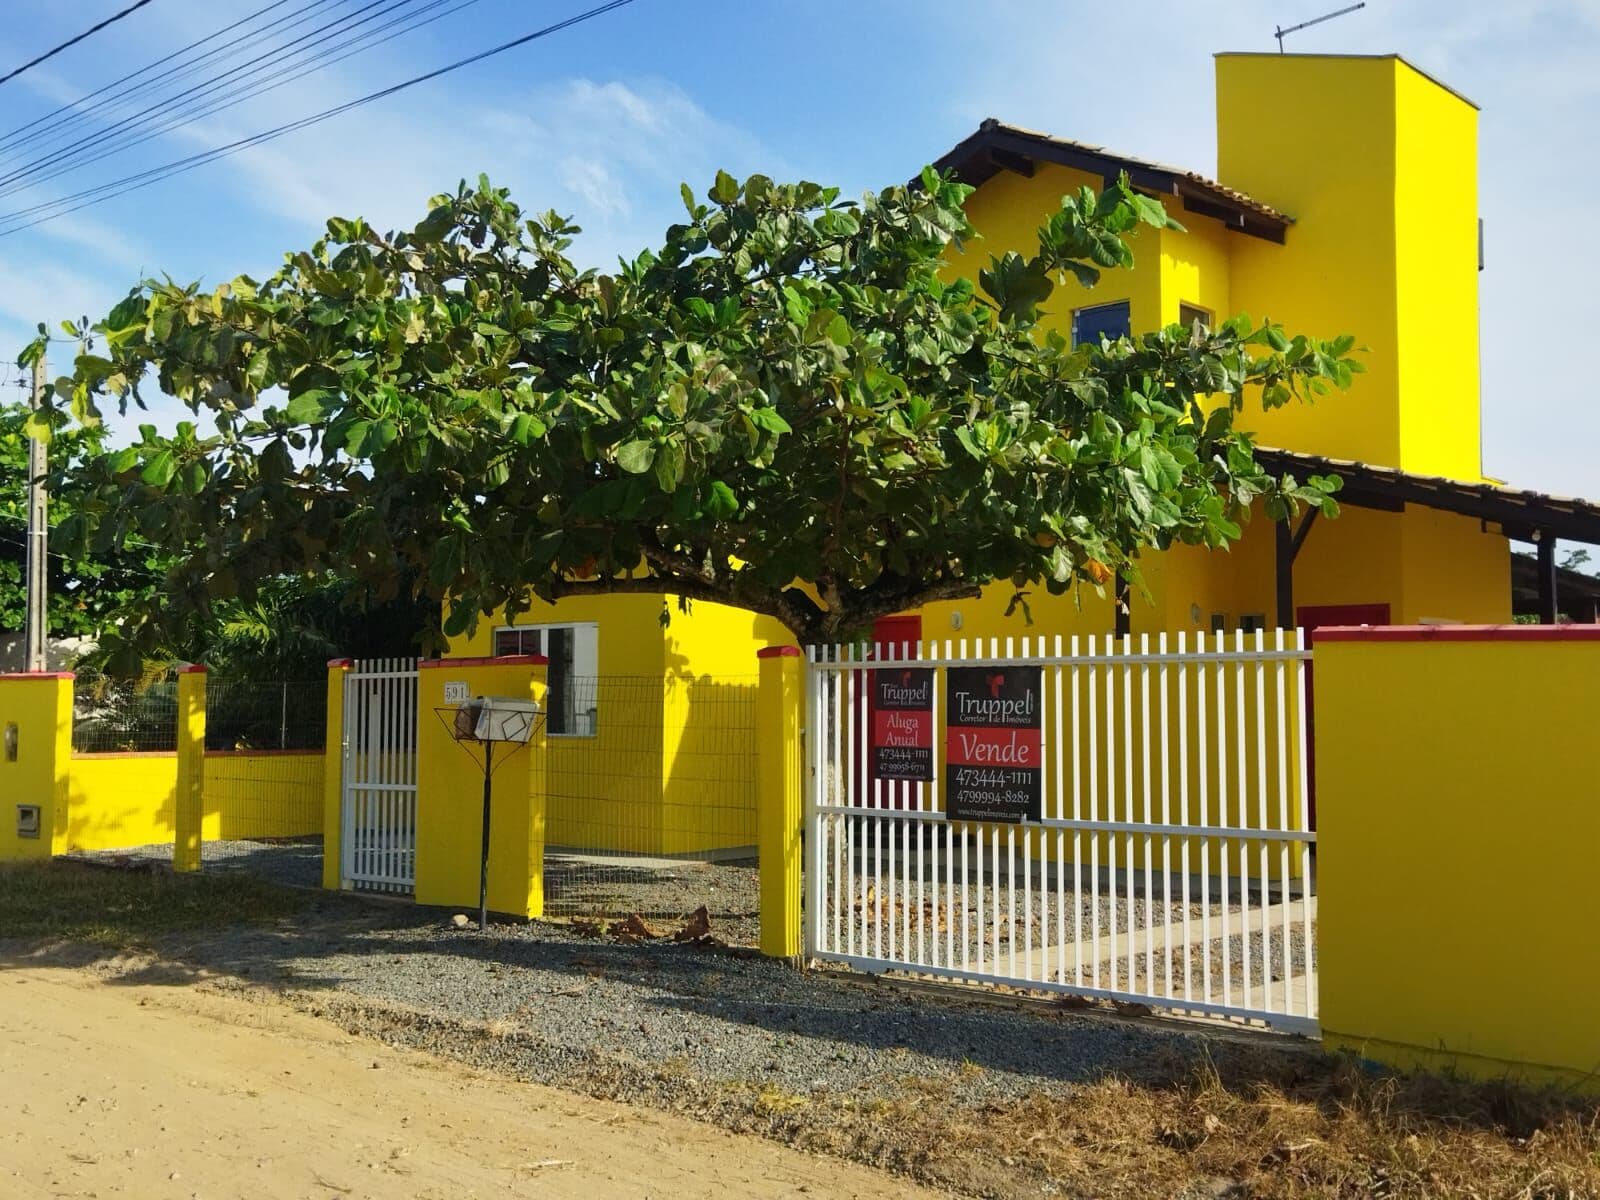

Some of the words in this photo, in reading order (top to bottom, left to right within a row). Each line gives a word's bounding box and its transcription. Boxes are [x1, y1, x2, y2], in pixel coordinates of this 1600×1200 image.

[446, 687, 465, 700] 591
[881, 680, 926, 704] Truppel
[955, 689, 1031, 722] Truppel
[887, 711, 919, 734] Aluga
[885, 731, 919, 746] Anual
[960, 731, 1029, 763] Vende
[955, 768, 1032, 788] 473444-1111
[957, 790, 1030, 805] 4799994-8282
